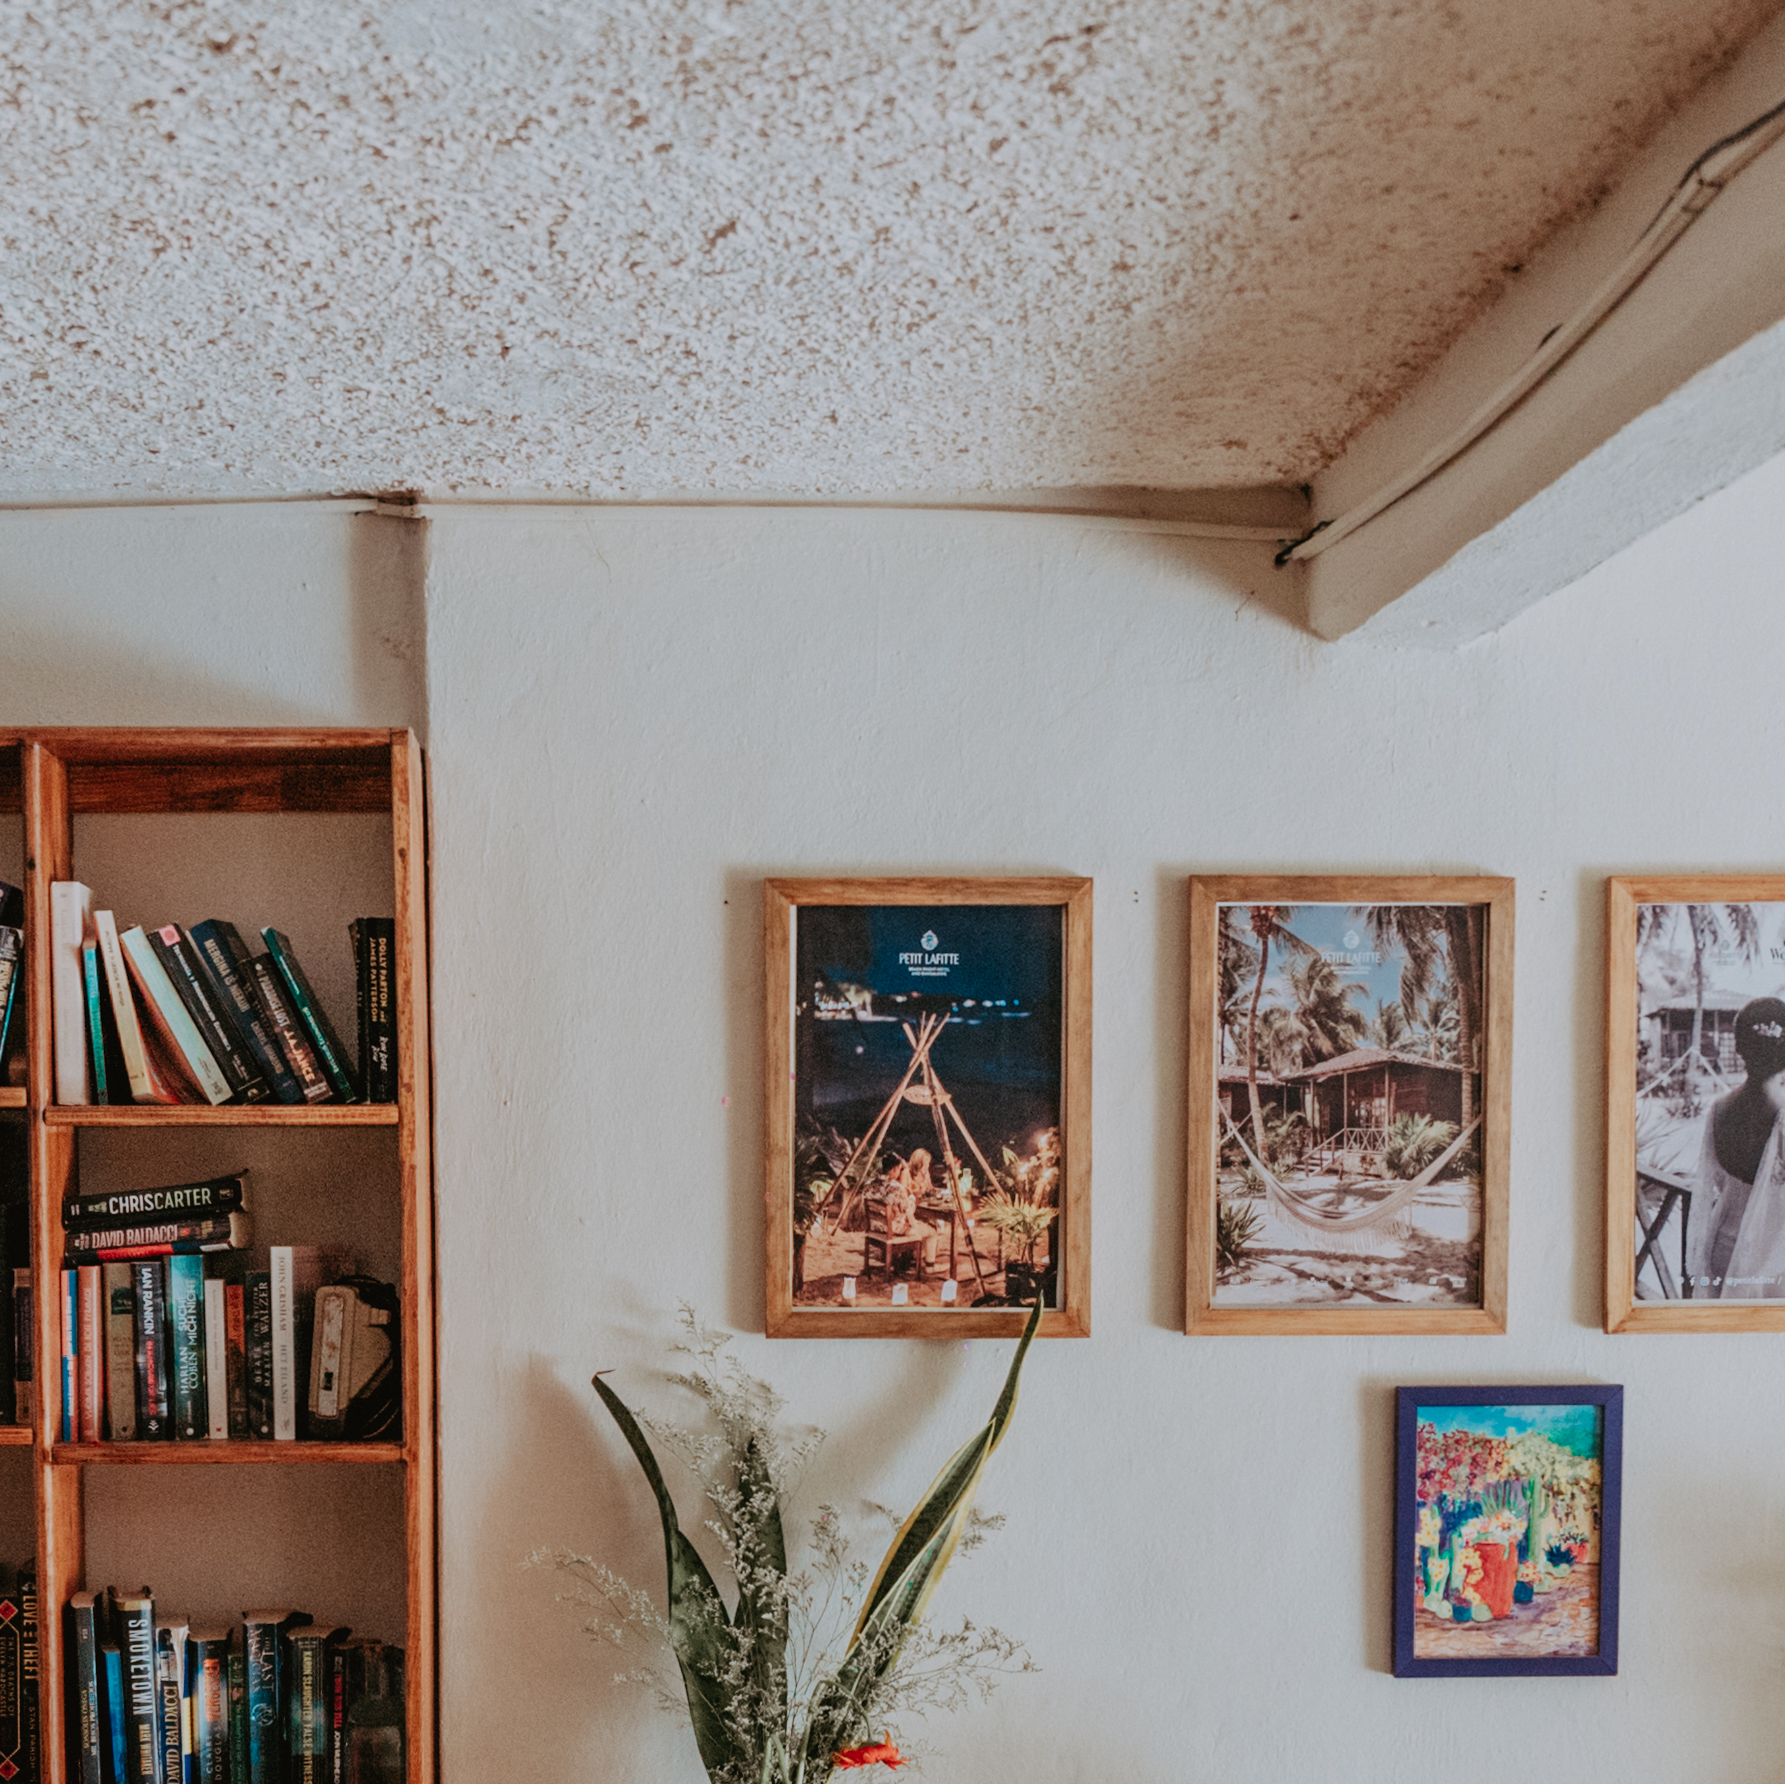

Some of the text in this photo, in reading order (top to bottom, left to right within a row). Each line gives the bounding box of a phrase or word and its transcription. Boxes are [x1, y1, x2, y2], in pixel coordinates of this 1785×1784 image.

[369, 937, 378, 1022] JAMES PATTERSON
[378, 937, 388, 1008] DOLLY PARTON
[898, 952, 960, 965] PETIT LAFITTE
[91, 1224, 178, 1249] DAVID BALDACCI
[141, 1267, 155, 1336] IAN RANKIN
[258, 1281, 269, 1334] WALZER
[278, 1256, 287, 1332] JOHN GRISHAM
[187, 1314, 198, 1345] MICH
[180, 1346, 189, 1394] HARLAN
[188, 1352, 198, 1389] COBEN
[22, 1596, 38, 1627] LOVE
[23, 1643, 39, 1681] THEFT
[128, 1618, 153, 1716] SMOKETOWN
[259, 1651, 275, 1692] LAST
[164, 1685, 179, 1746] BALDACCI
[301, 1676, 313, 1720] SLAUGHTER
[138, 1723, 152, 1742] MARK
[214, 1725, 223, 1780] DOUGLAS
[302, 1723, 314, 1748] FALSE
